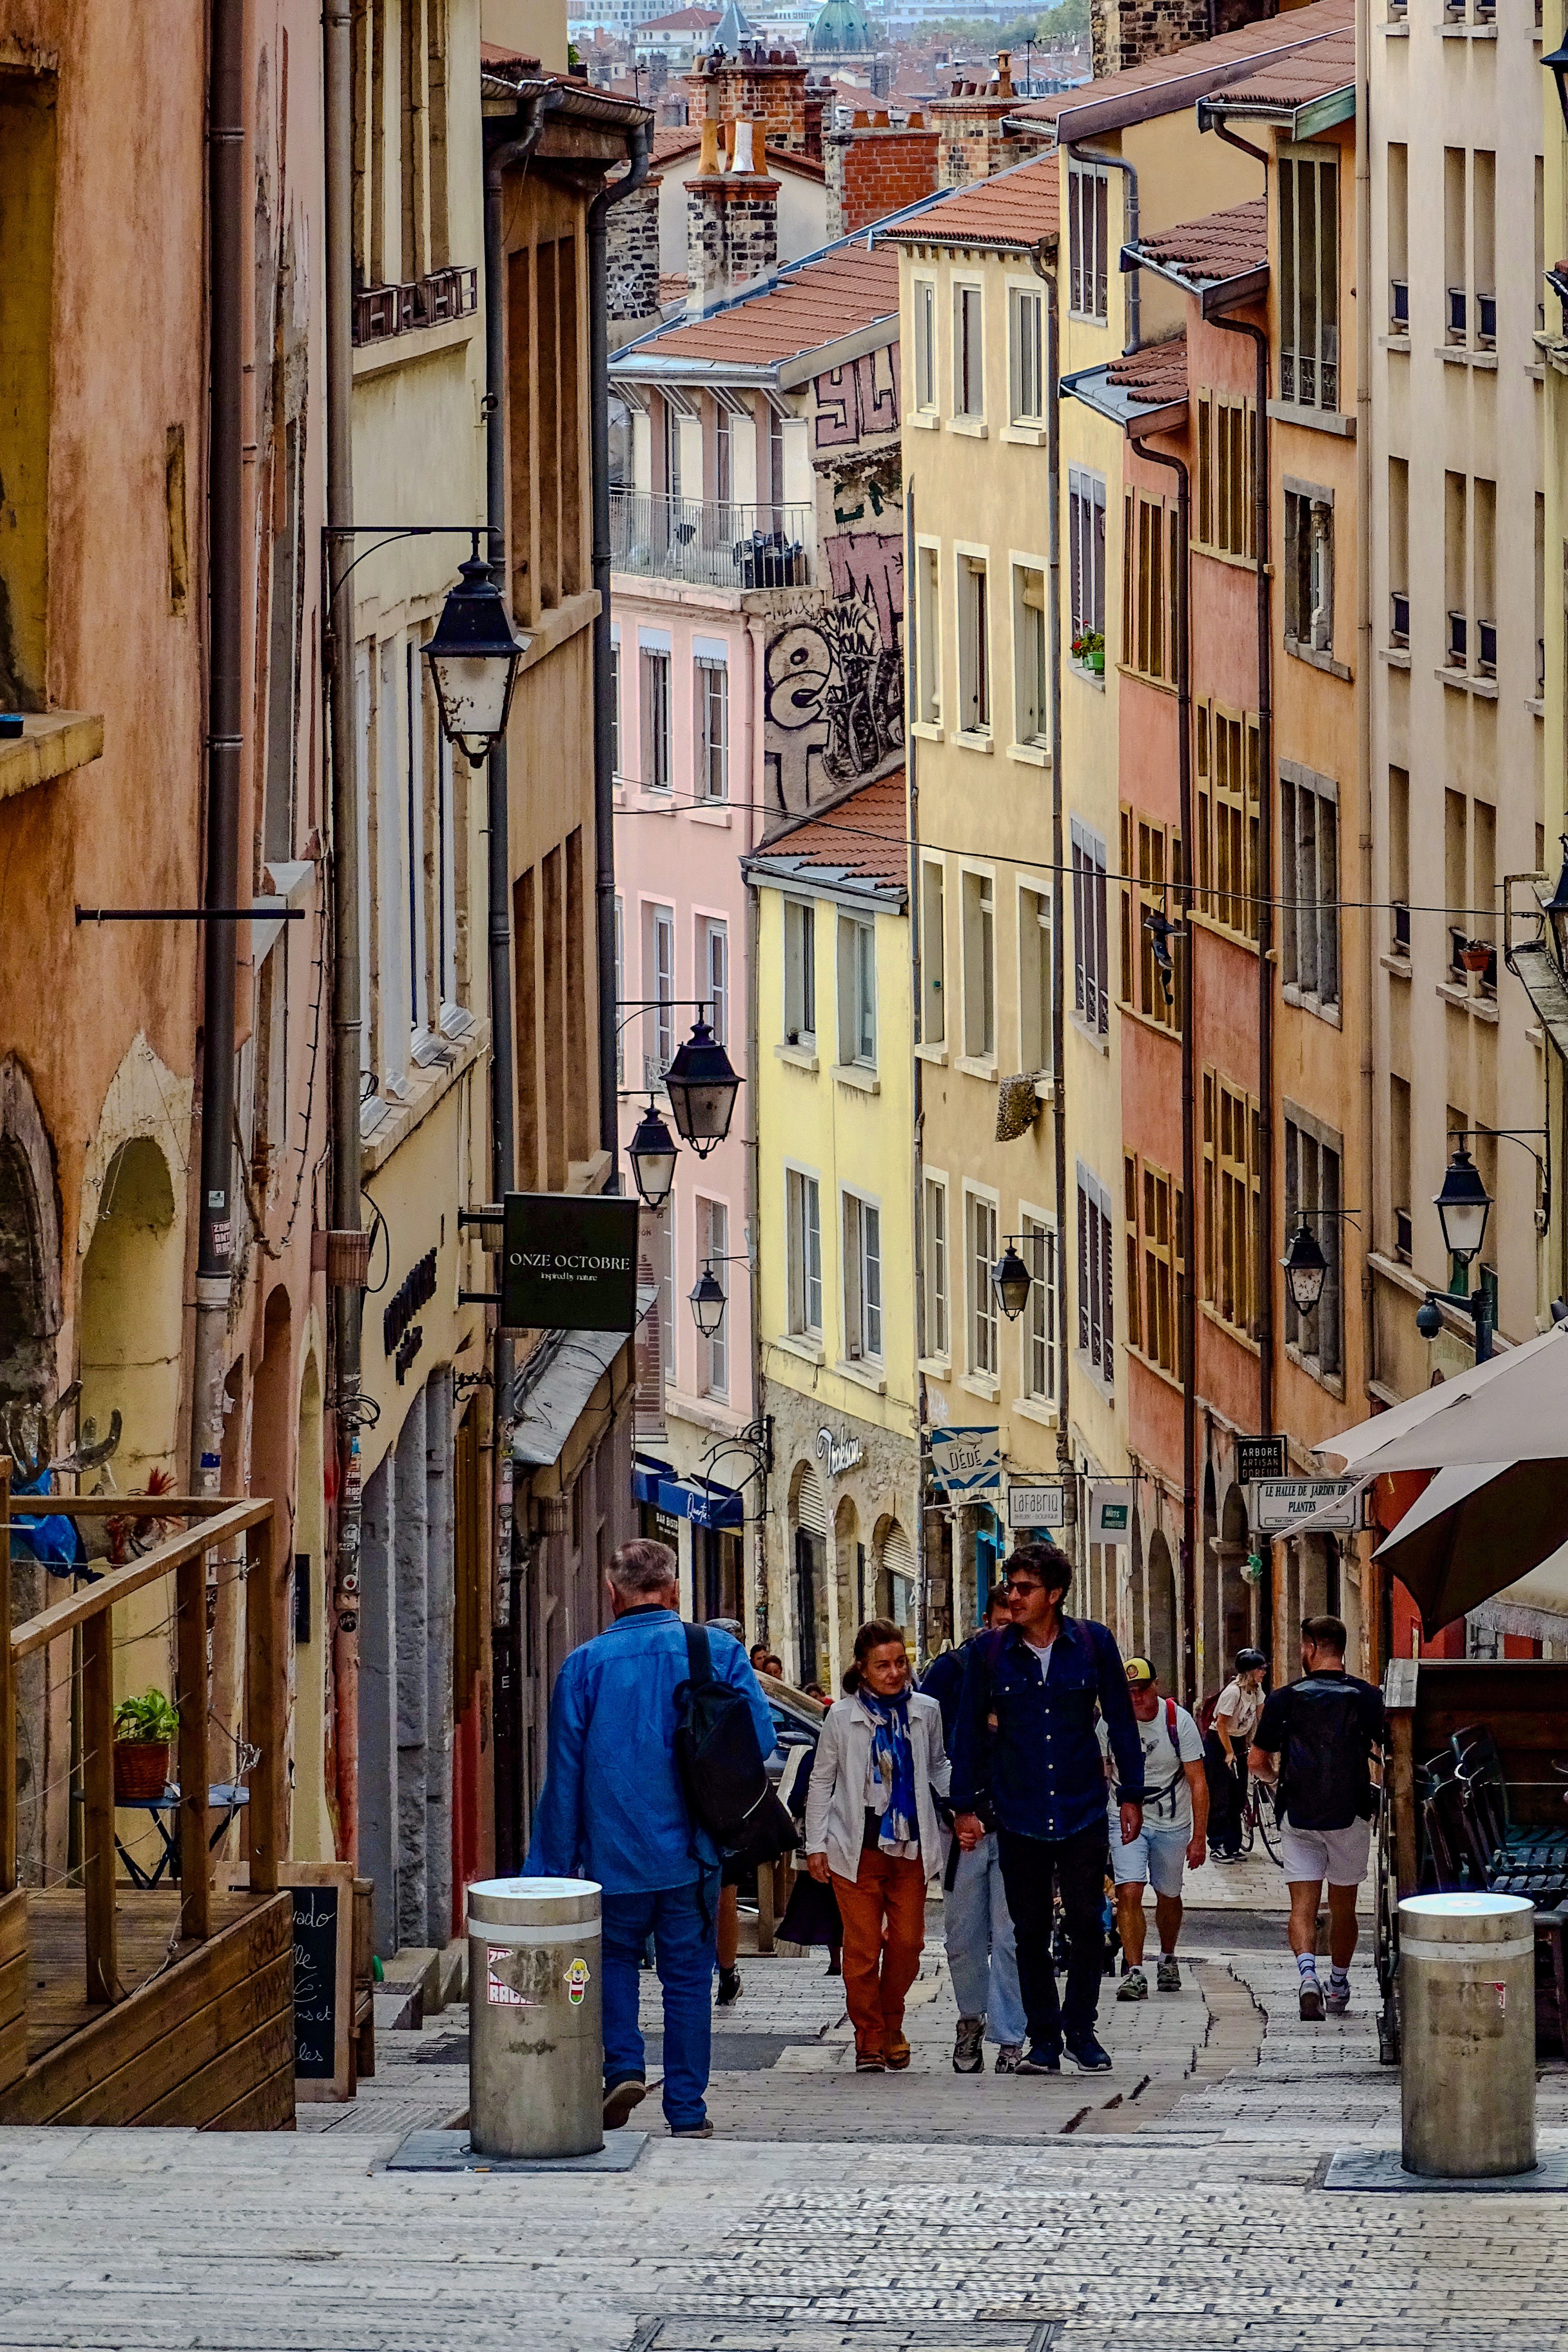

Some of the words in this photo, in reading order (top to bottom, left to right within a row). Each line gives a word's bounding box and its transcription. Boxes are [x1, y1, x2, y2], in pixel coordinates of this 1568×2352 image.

[510, 1253, 550, 1266] ONZE
[554, 1255, 630, 1270] OCTOBRE
[1242, 1447, 1278, 1457] ARBORE
[950, 1445, 982, 1471] DÉDÉ
[1242, 1458, 1278, 1467] ARTISAN
[1242, 1468, 1278, 1478] DOREUR
[1265, 1486, 1274, 1497] LE
[1275, 1485, 1296, 1497] HALLE
[1298, 1485, 1307, 1496] DE
[1310, 1485, 1335, 1498] JARDIN
[1338, 1485, 1348, 1495] DE
[1289, 1501, 1316, 1512] PLANTES
